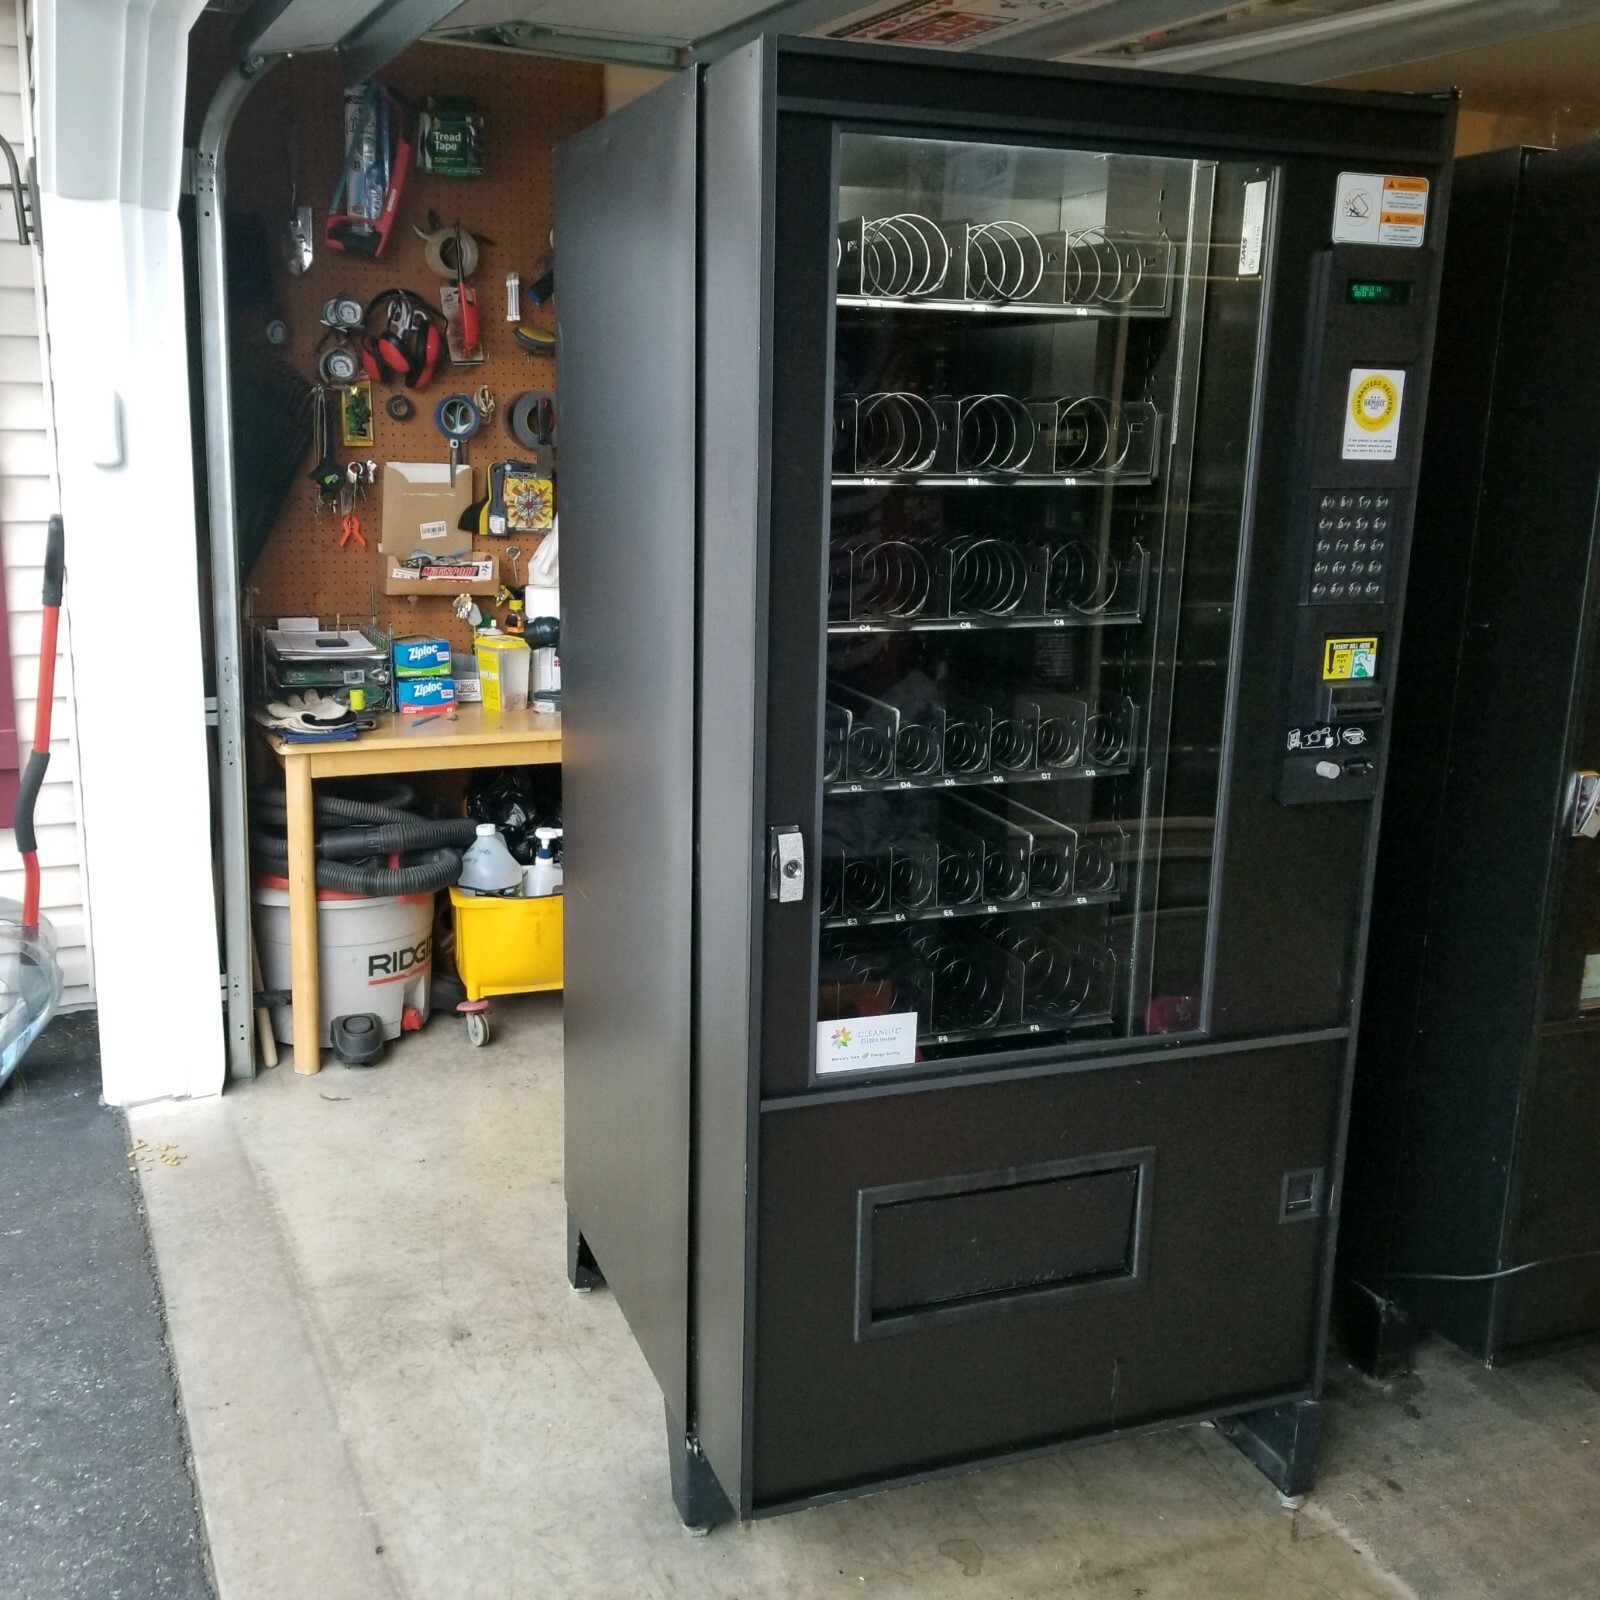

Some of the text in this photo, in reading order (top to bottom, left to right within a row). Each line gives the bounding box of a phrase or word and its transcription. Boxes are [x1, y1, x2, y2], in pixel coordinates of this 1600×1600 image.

[434, 132, 462, 142] Tread
[434, 140, 457, 152] Tape
[1357, 380, 1394, 415] GUARANTEED DELIVERY
[408, 644, 439, 660] Ziploc
[414, 682, 443, 697] Ziploc
[368, 934, 432, 977] RIDGI
